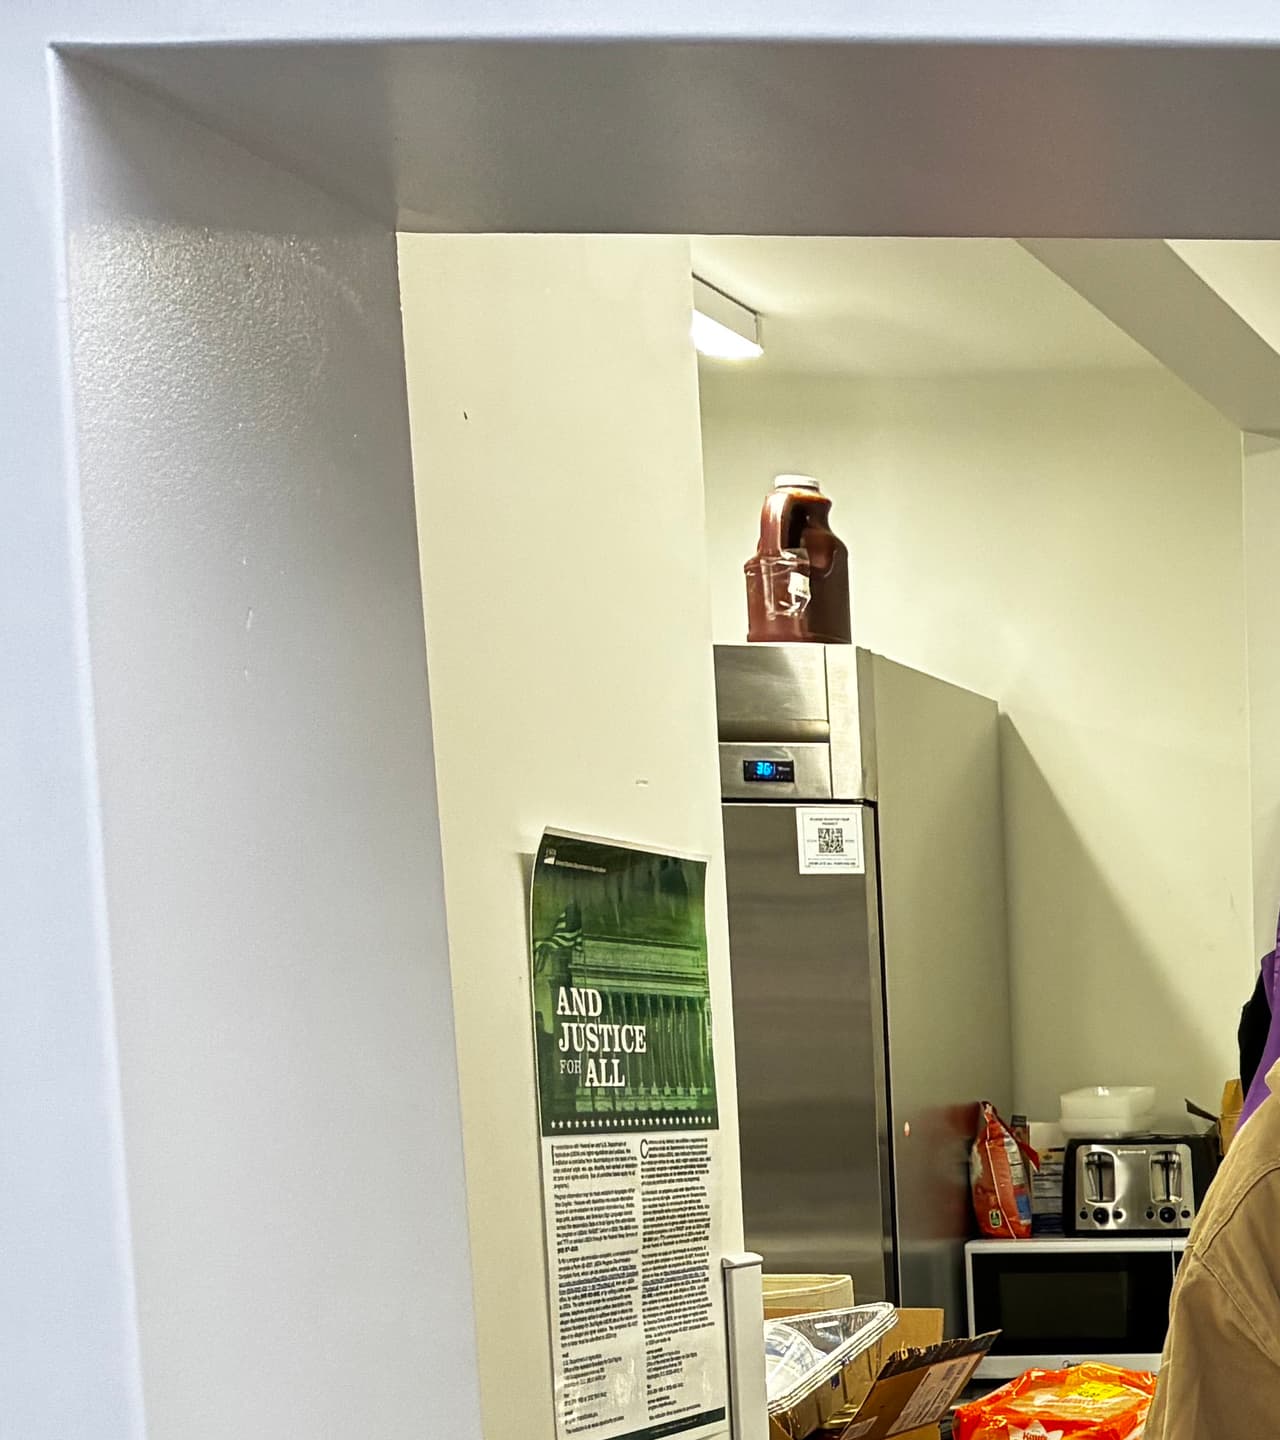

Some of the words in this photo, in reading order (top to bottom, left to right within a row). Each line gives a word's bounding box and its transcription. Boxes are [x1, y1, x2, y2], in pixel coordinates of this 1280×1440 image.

[756, 761, 771, 776] 36
[556, 986, 602, 1017] AND
[558, 1023, 647, 1054] JUSTICE
[560, 1059, 582, 1076] FOR
[584, 1057, 625, 1088] ALL
